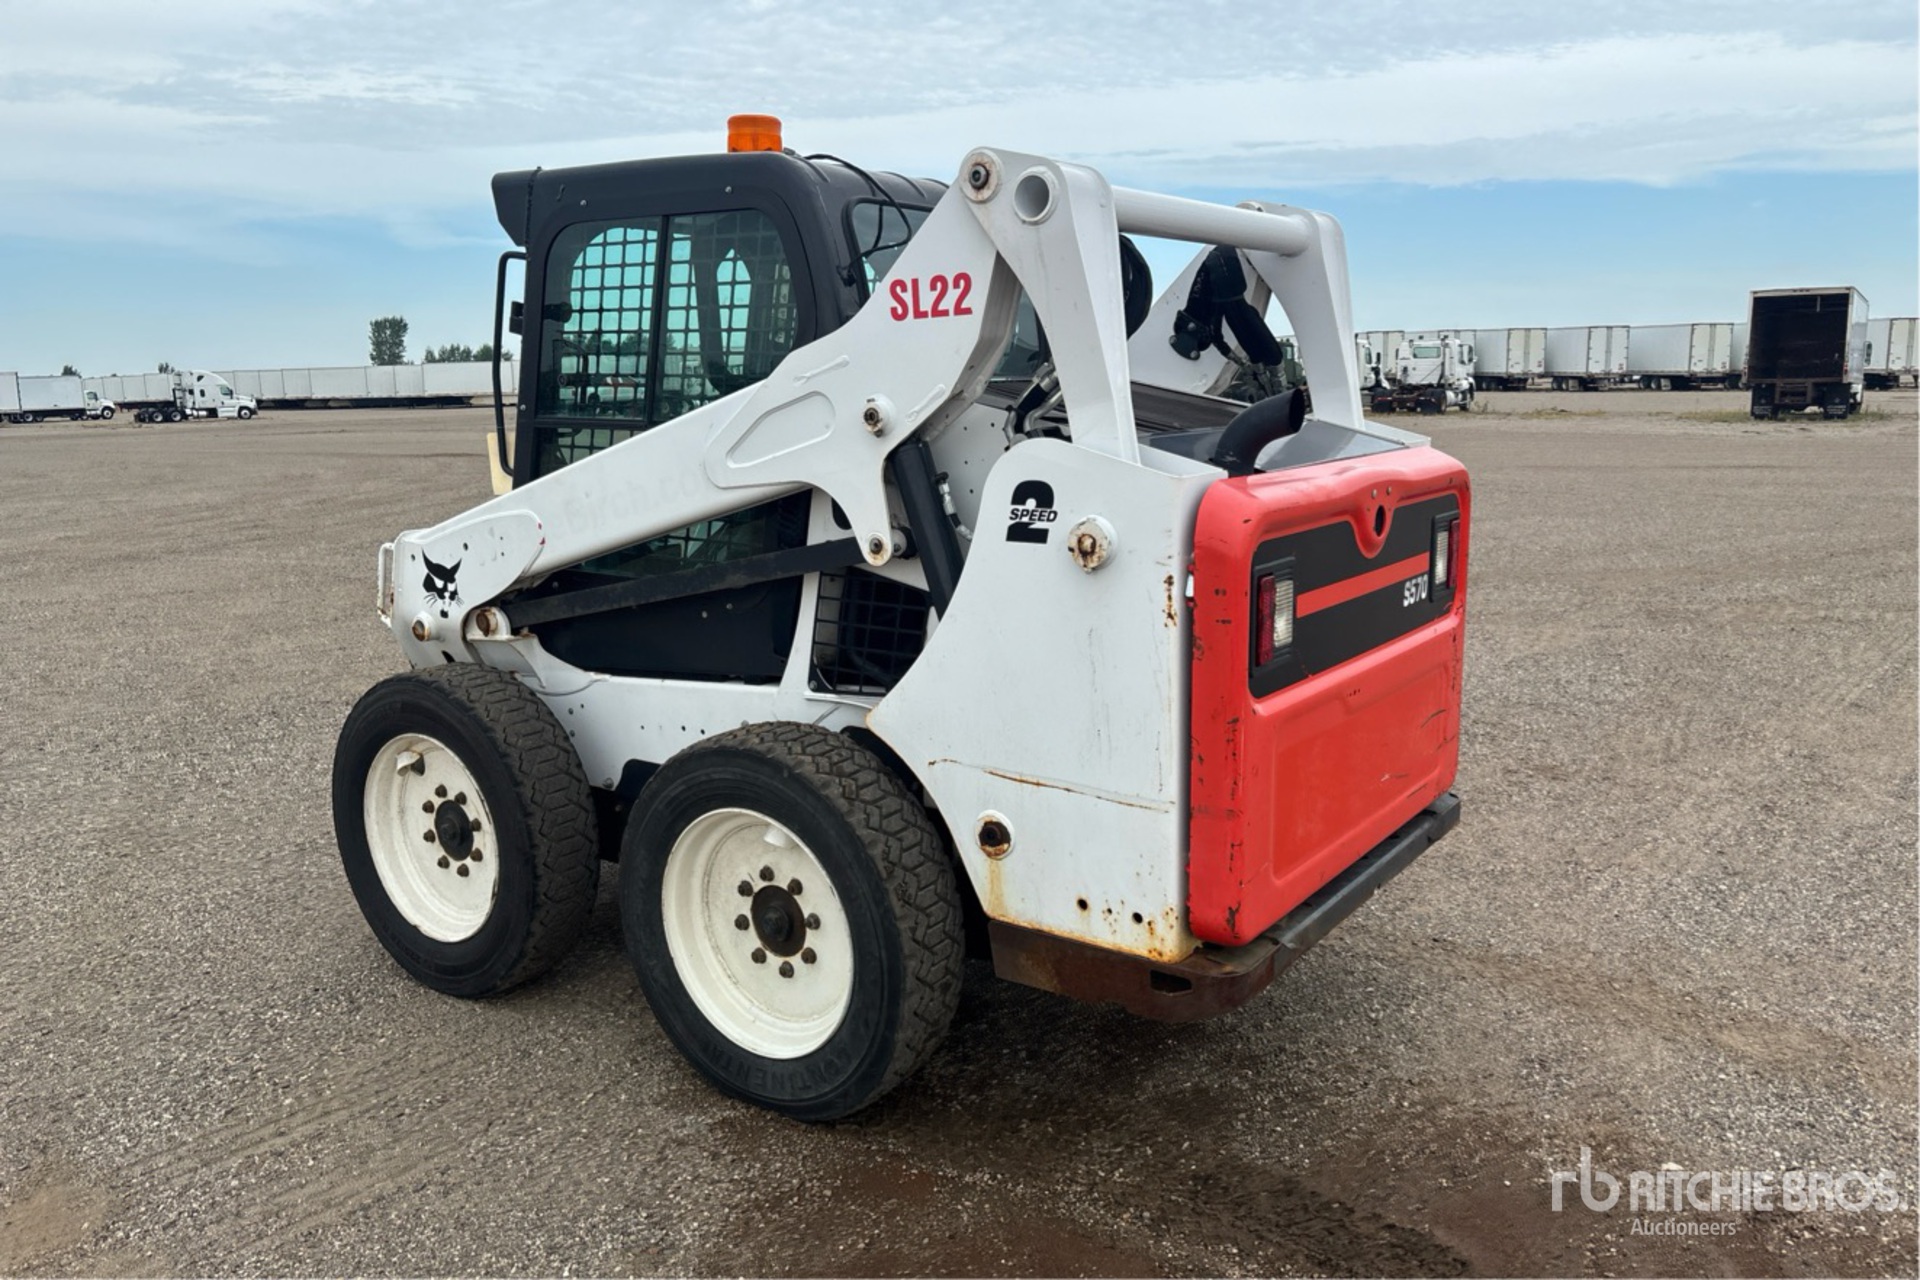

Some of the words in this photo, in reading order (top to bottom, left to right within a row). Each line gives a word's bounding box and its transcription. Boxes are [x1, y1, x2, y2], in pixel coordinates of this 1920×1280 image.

[889, 272, 973, 322] SL22
[1005, 479, 1055, 545] 2
[1009, 507, 1058, 523] SPEED
[1403, 574, 1429, 607] S570
